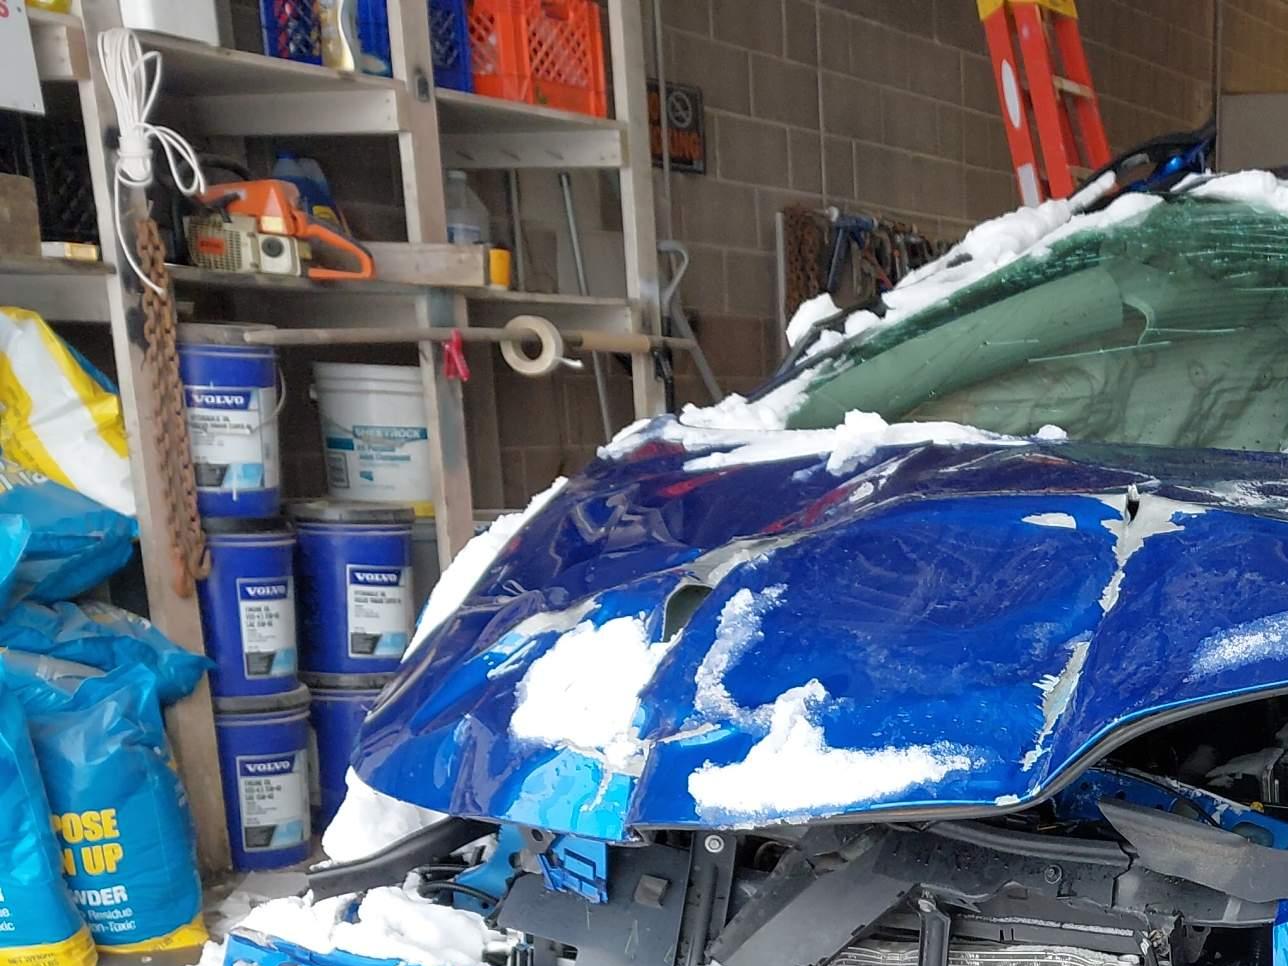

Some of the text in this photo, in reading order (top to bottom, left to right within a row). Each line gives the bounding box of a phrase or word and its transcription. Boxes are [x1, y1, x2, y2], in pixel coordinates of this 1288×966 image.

[192, 394, 244, 406] VOLVO
[353, 571, 398, 583] VOLVO
[245, 585, 286, 597] VOLVO
[245, 760, 290, 773] VOLVO
[81, 842, 123, 877] UP
